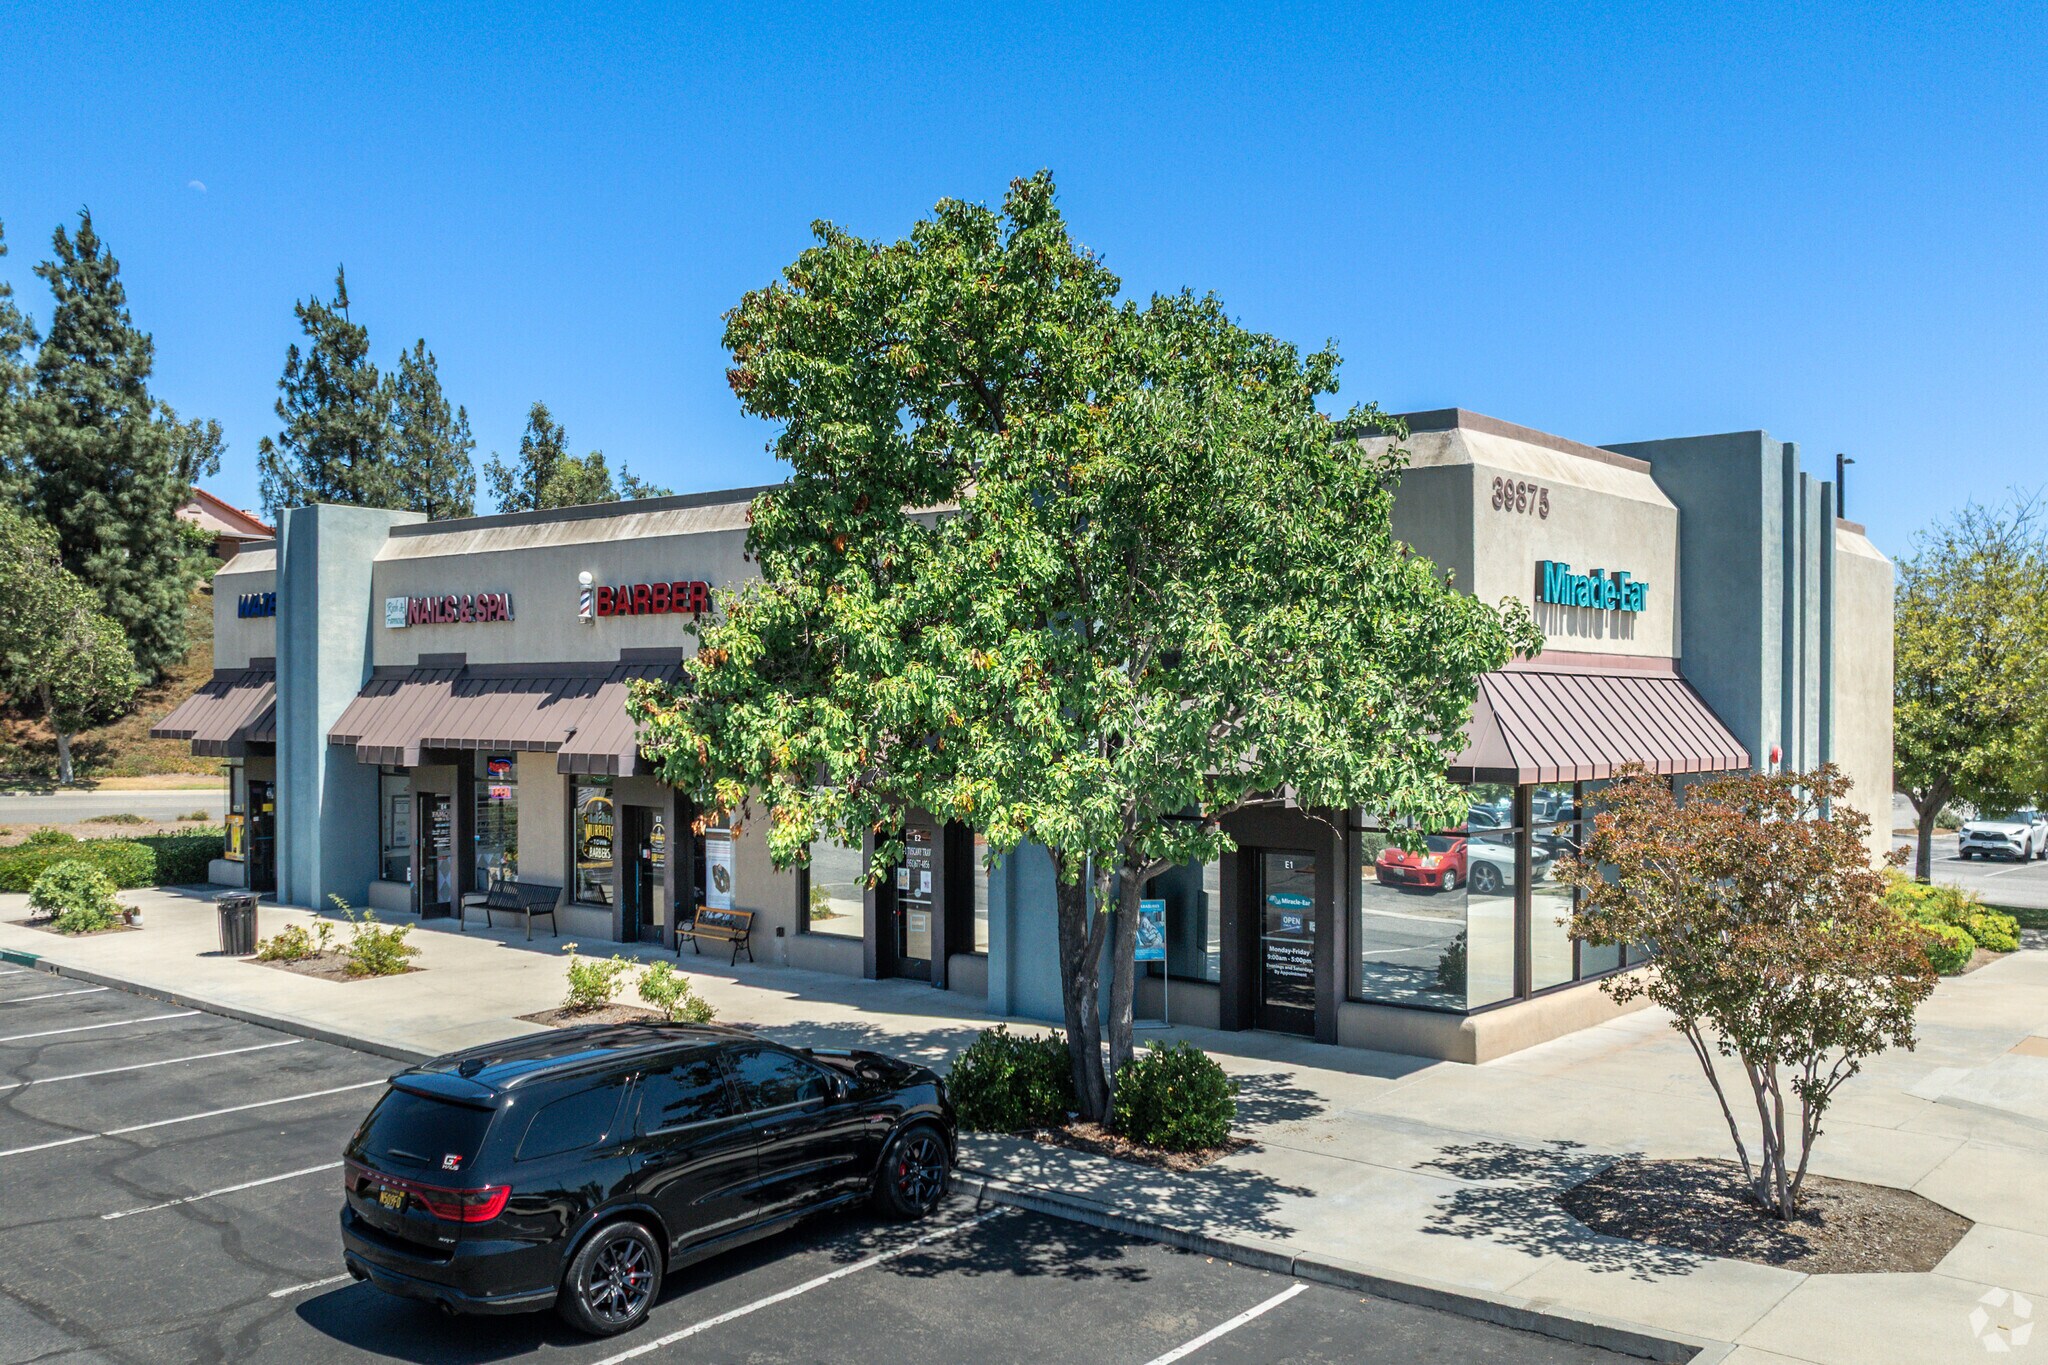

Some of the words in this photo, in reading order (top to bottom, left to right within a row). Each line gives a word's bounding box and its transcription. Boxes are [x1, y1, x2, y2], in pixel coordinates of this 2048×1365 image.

[1492, 476, 1549, 520] 39875
[1536, 560, 1649, 612] Miracle-Ear
[597, 581, 708, 616] BARBER
[408, 595, 457, 625] NAILS
[460, 594, 476, 622] &
[475, 592, 512, 622] SPA
[589, 846, 611, 859] BARBERS
[1284, 860, 1294, 869] E1
[1281, 897, 1311, 907] Miracle-Ear
[1282, 916, 1301, 925] OPEN
[1269, 945, 1310, 957] Monday-Friday
[1267, 953, 1288, 961] 9:00am
[1291, 956, 1312, 965] 5:00pm
[367, 1171, 407, 1188] DODGE
